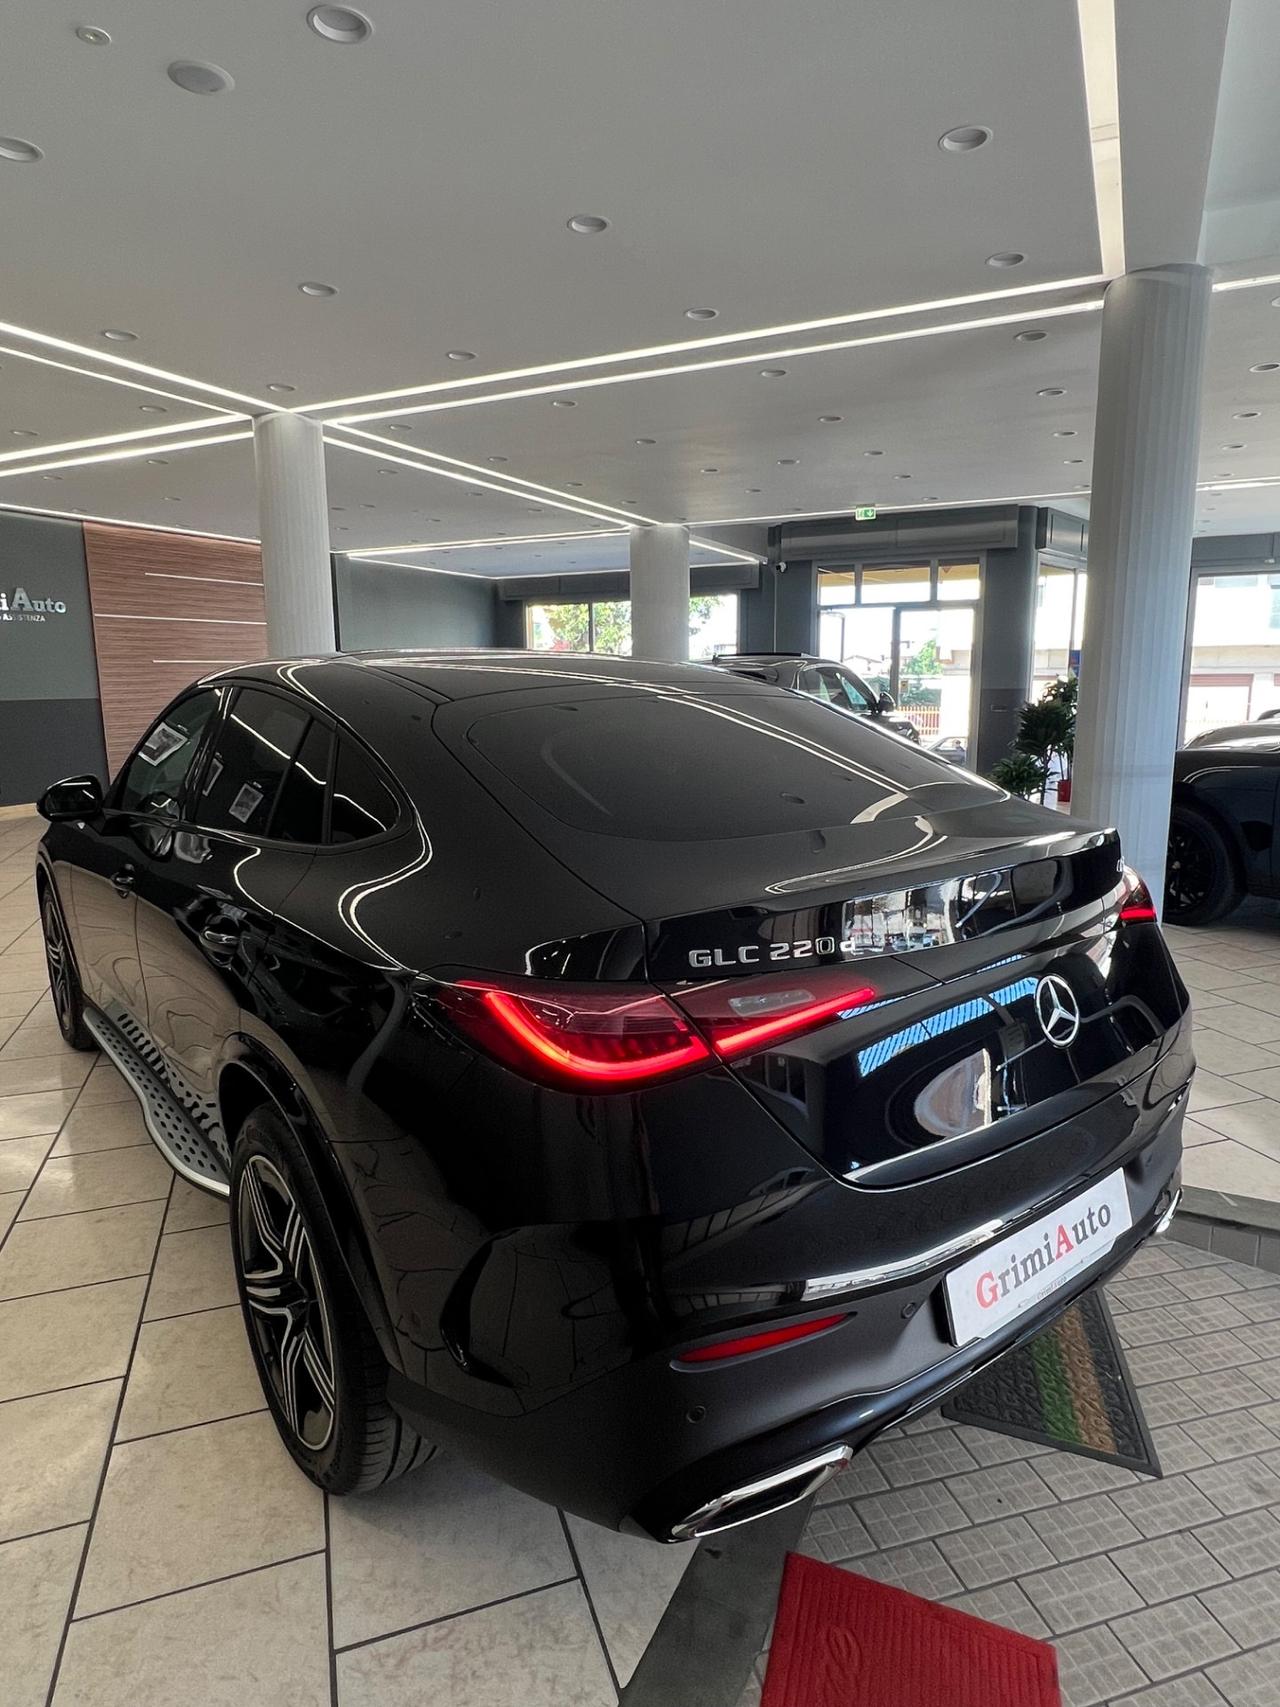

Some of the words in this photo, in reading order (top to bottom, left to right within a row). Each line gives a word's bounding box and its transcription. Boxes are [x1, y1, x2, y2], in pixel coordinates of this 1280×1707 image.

[688, 945, 760, 969] GLC
[769, 936, 835, 961] 220
[976, 1204, 1112, 1309] GrimiAuto
